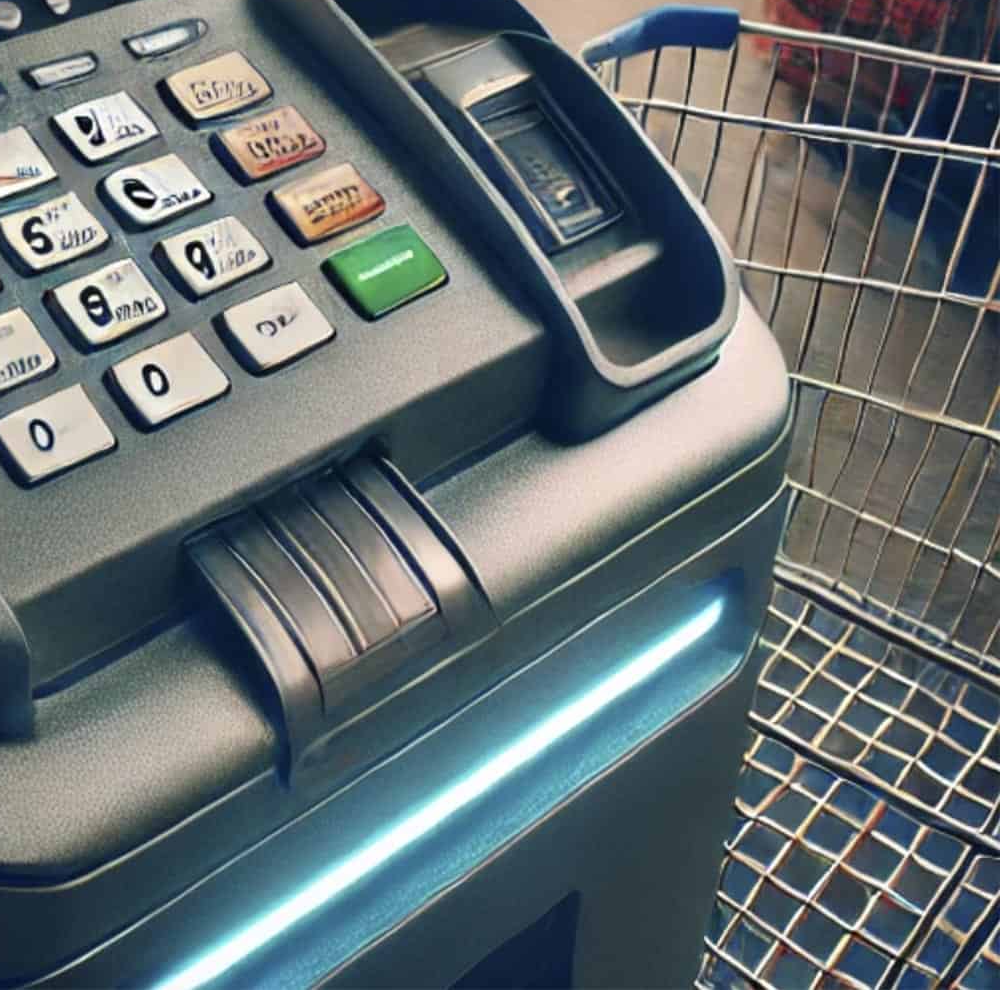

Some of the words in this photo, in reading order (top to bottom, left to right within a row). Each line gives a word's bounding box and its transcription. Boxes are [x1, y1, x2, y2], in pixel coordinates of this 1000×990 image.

[21, 215, 54, 256] 6
[184, 240, 217, 281] 9
[141, 363, 170, 397] 0
[28, 418, 55, 452] 0
